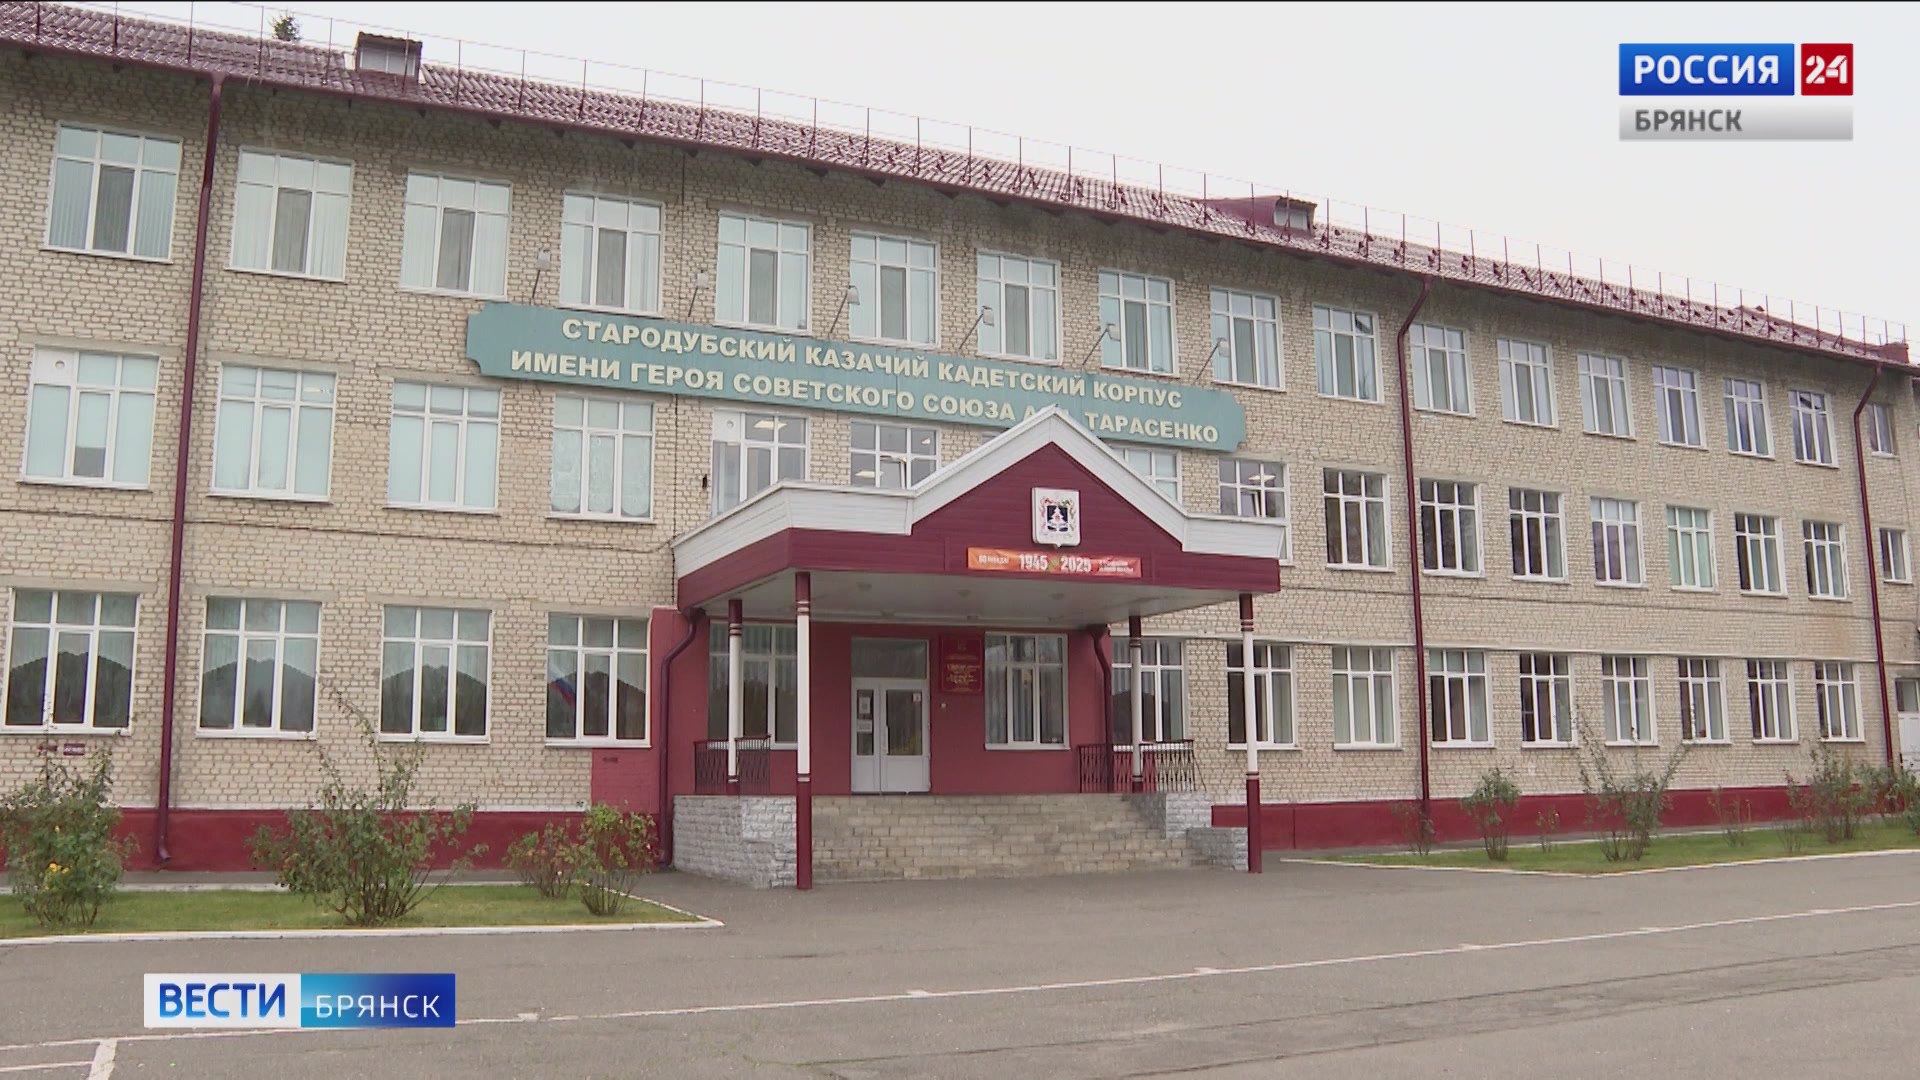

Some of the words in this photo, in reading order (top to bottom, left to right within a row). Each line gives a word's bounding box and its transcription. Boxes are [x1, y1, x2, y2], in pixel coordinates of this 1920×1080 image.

[511, 349, 620, 381] ИМЕНИ
[631, 362, 724, 391] ГЕРОЯ
[733, 372, 915, 410] СОВЕТСКОГО
[923, 393, 1016, 420] СОЮЗА
[1084, 411, 1219, 442] ТАРАСЕНКО
[562, 318, 796, 363] СТАРОДУБСКИЙ
[805, 345, 929, 378] КАЗАЧИЙ
[938, 361, 1085, 396] КАДЕТСКИЙ
[1093, 380, 1182, 408] КОРПУС
[1019, 553, 1048, 571] 1945
